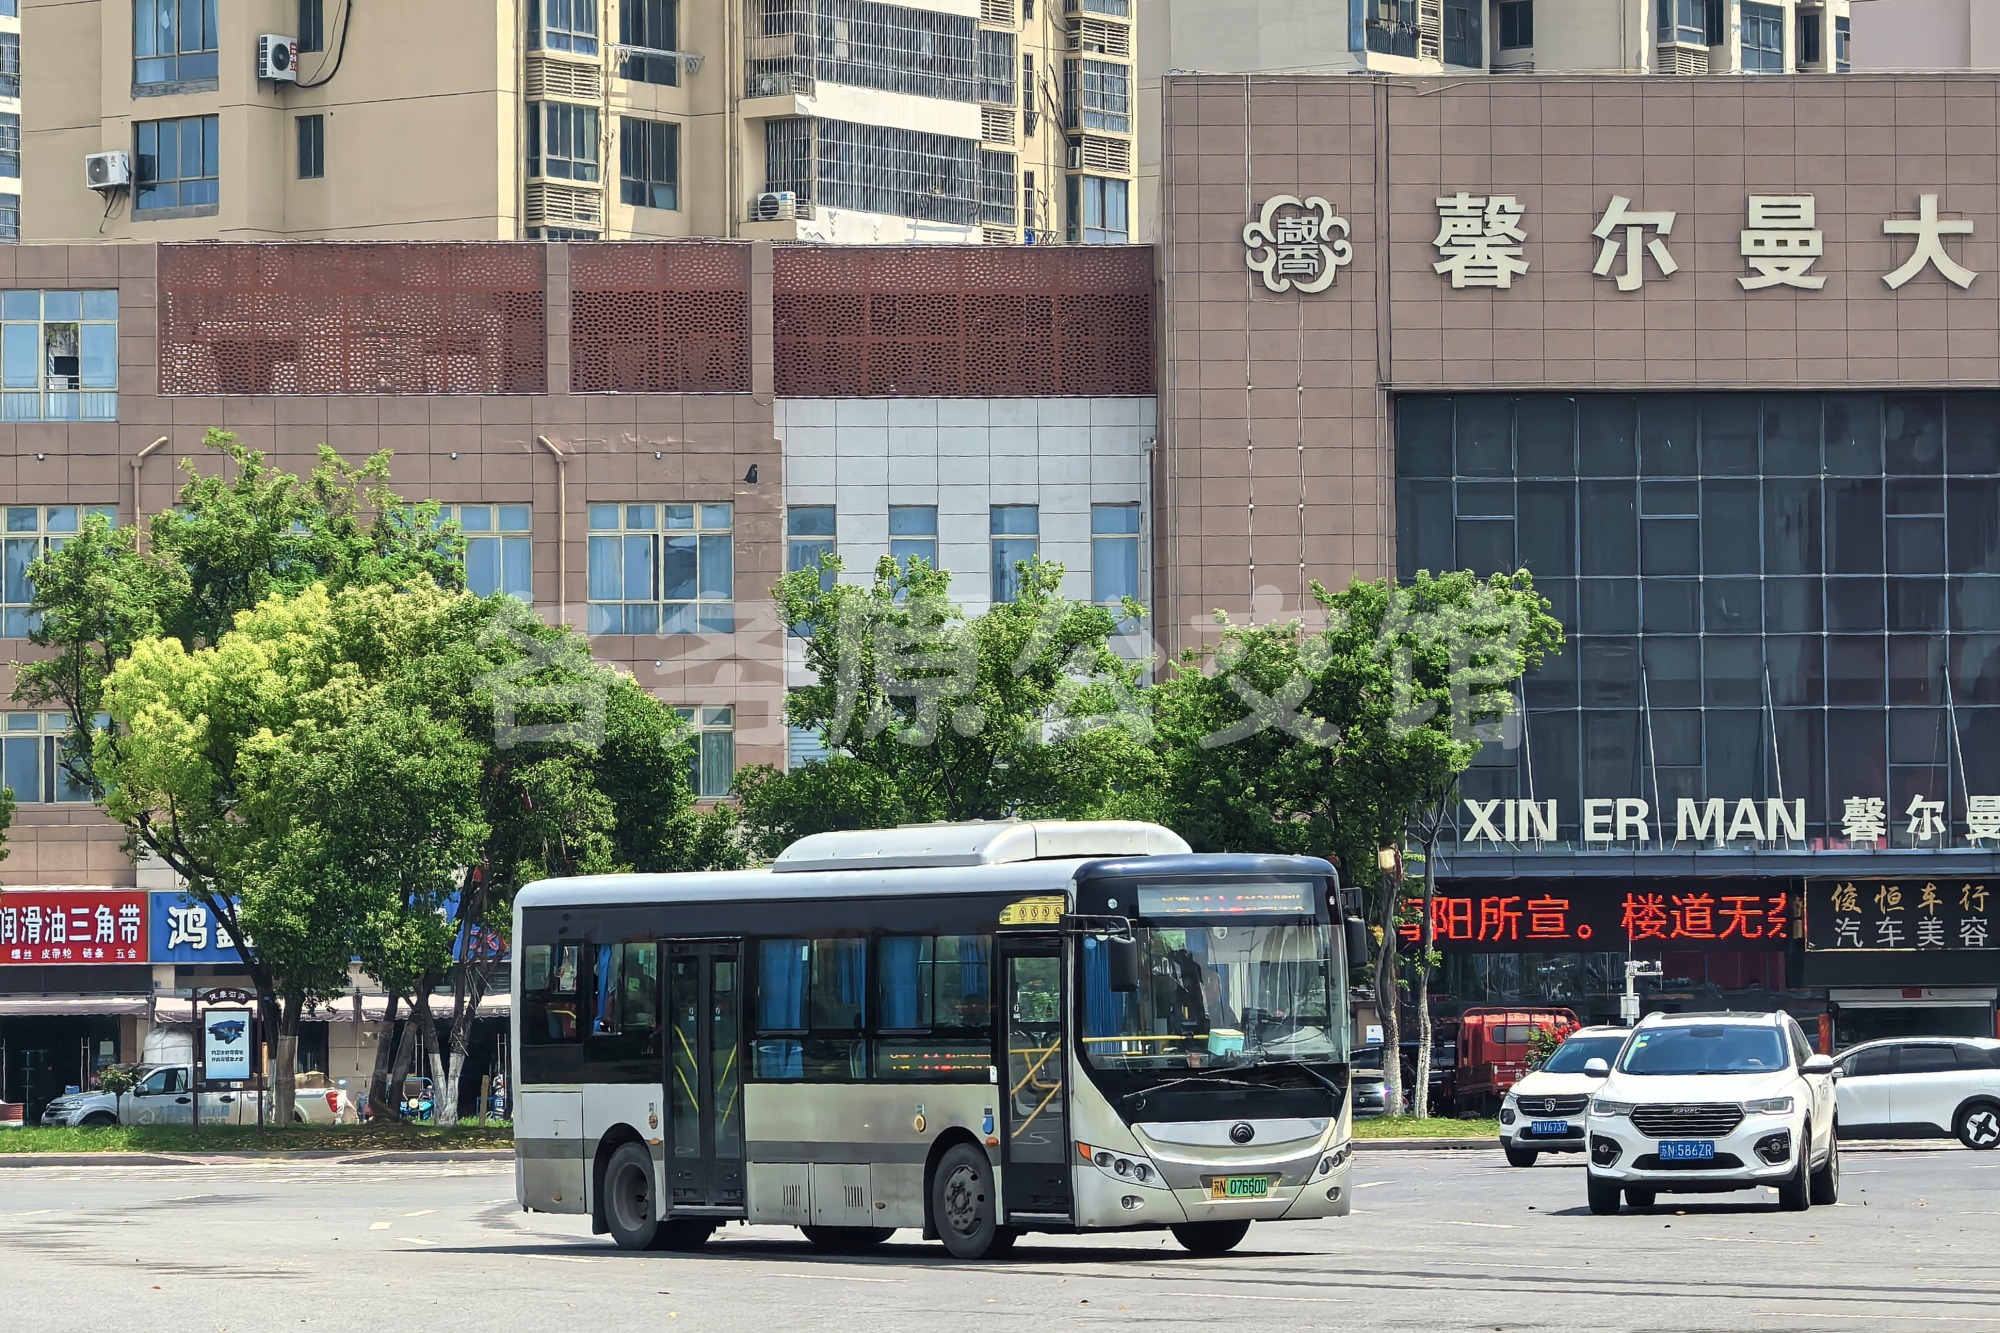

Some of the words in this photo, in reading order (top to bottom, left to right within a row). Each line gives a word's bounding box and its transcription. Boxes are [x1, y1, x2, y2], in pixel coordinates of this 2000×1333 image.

[1432, 191, 1978, 291] 馨尔曼大
[1463, 799, 1557, 841] XIN
[1585, 799, 1650, 841] ER
[1677, 798, 1806, 841] MAN
[1841, 794, 2000, 842] 馨尔曼
[1831, 882, 1990, 915] 俊恒车行
[0, 904, 141, 945] 润滑油三角带
[1834, 916, 1989, 948] 汽车美容
[116, 948, 137, 959] 五金
